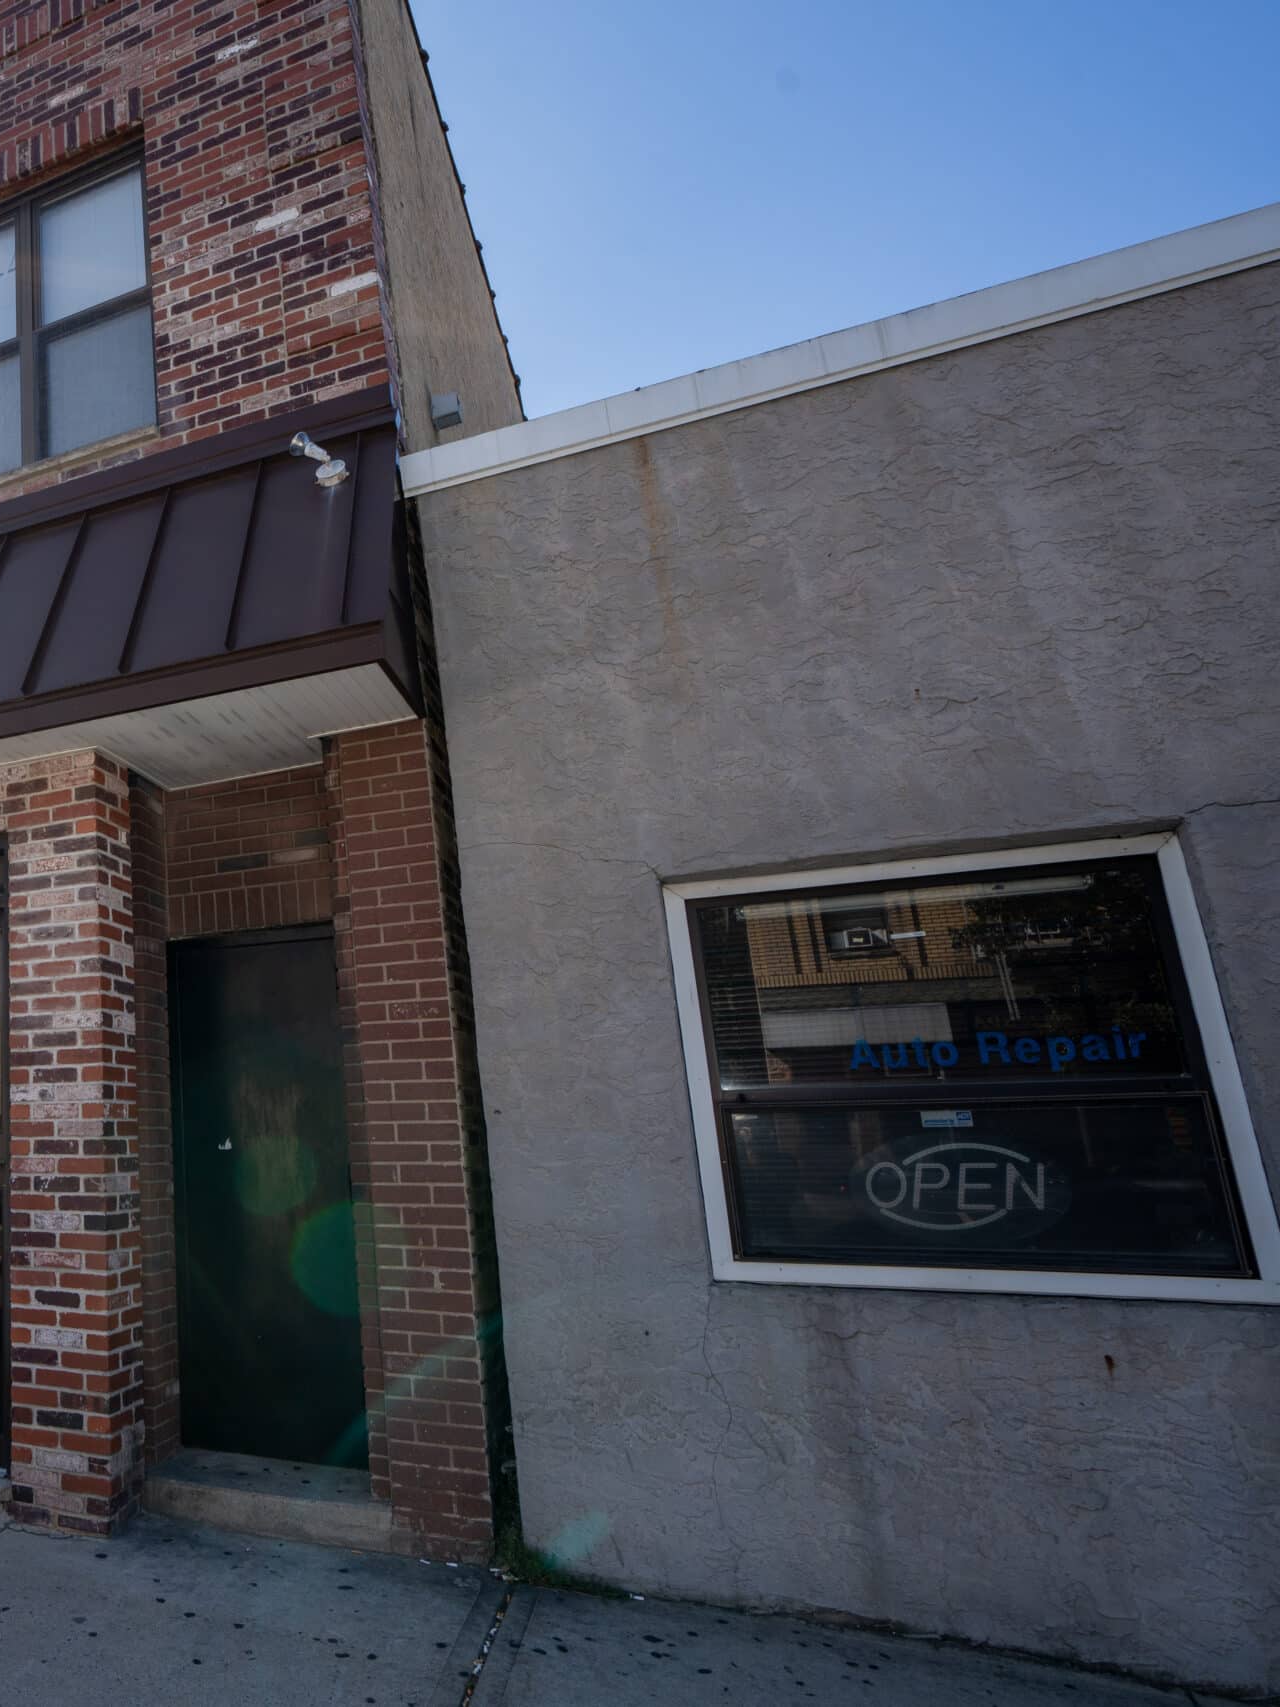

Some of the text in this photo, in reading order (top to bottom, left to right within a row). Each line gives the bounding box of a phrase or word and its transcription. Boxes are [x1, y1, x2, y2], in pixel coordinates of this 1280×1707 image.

[849, 1025, 1147, 1072] Auto Repair
[865, 1161, 1046, 1211] OPEN
